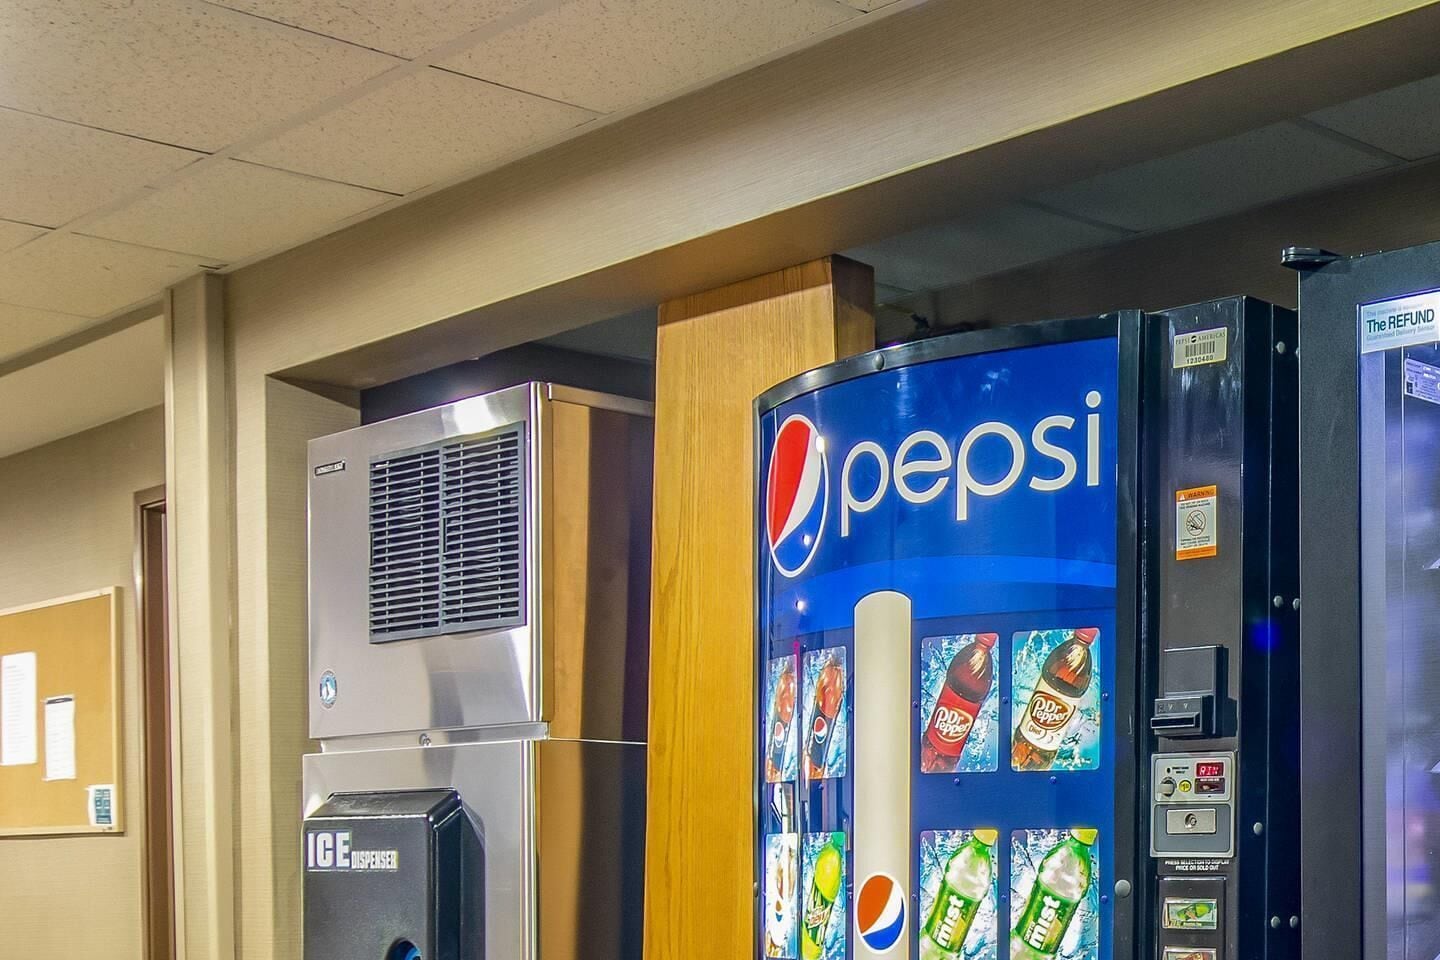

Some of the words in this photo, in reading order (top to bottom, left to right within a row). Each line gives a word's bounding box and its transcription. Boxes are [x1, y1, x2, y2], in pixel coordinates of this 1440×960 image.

[1366, 319, 1387, 333] The
[1388, 308, 1435, 330] REFUND
[841, 390, 1102, 537] pepsi
[1187, 489, 1215, 499] WARNING
[947, 710, 965, 724] Dr
[1032, 697, 1065, 723] Pepper
[1044, 700, 1062, 713] Dr
[935, 706, 972, 737] Pepper
[307, 831, 351, 868] ICE
[351, 850, 399, 870] DISPENSER
[937, 895, 965, 948] mist
[1029, 895, 1061, 950] mist
